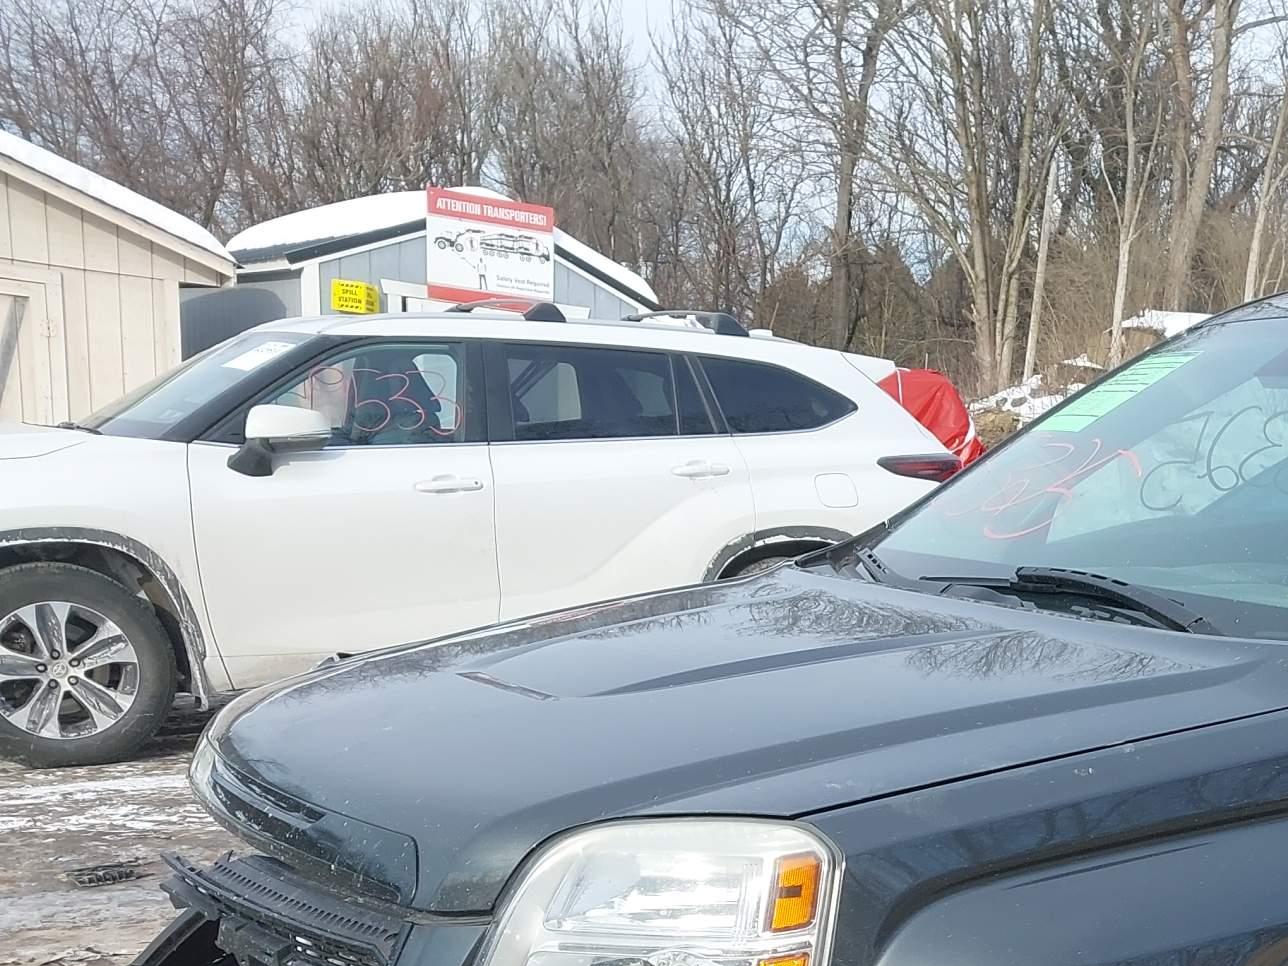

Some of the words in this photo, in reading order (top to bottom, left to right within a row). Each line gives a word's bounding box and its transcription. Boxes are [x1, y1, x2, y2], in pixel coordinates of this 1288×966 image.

[436, 198, 481, 216] ATTENTION
[483, 205, 547, 226] TRANSPORTERS!
[341, 288, 358, 296] SPILL
[338, 296, 362, 304] STATION
